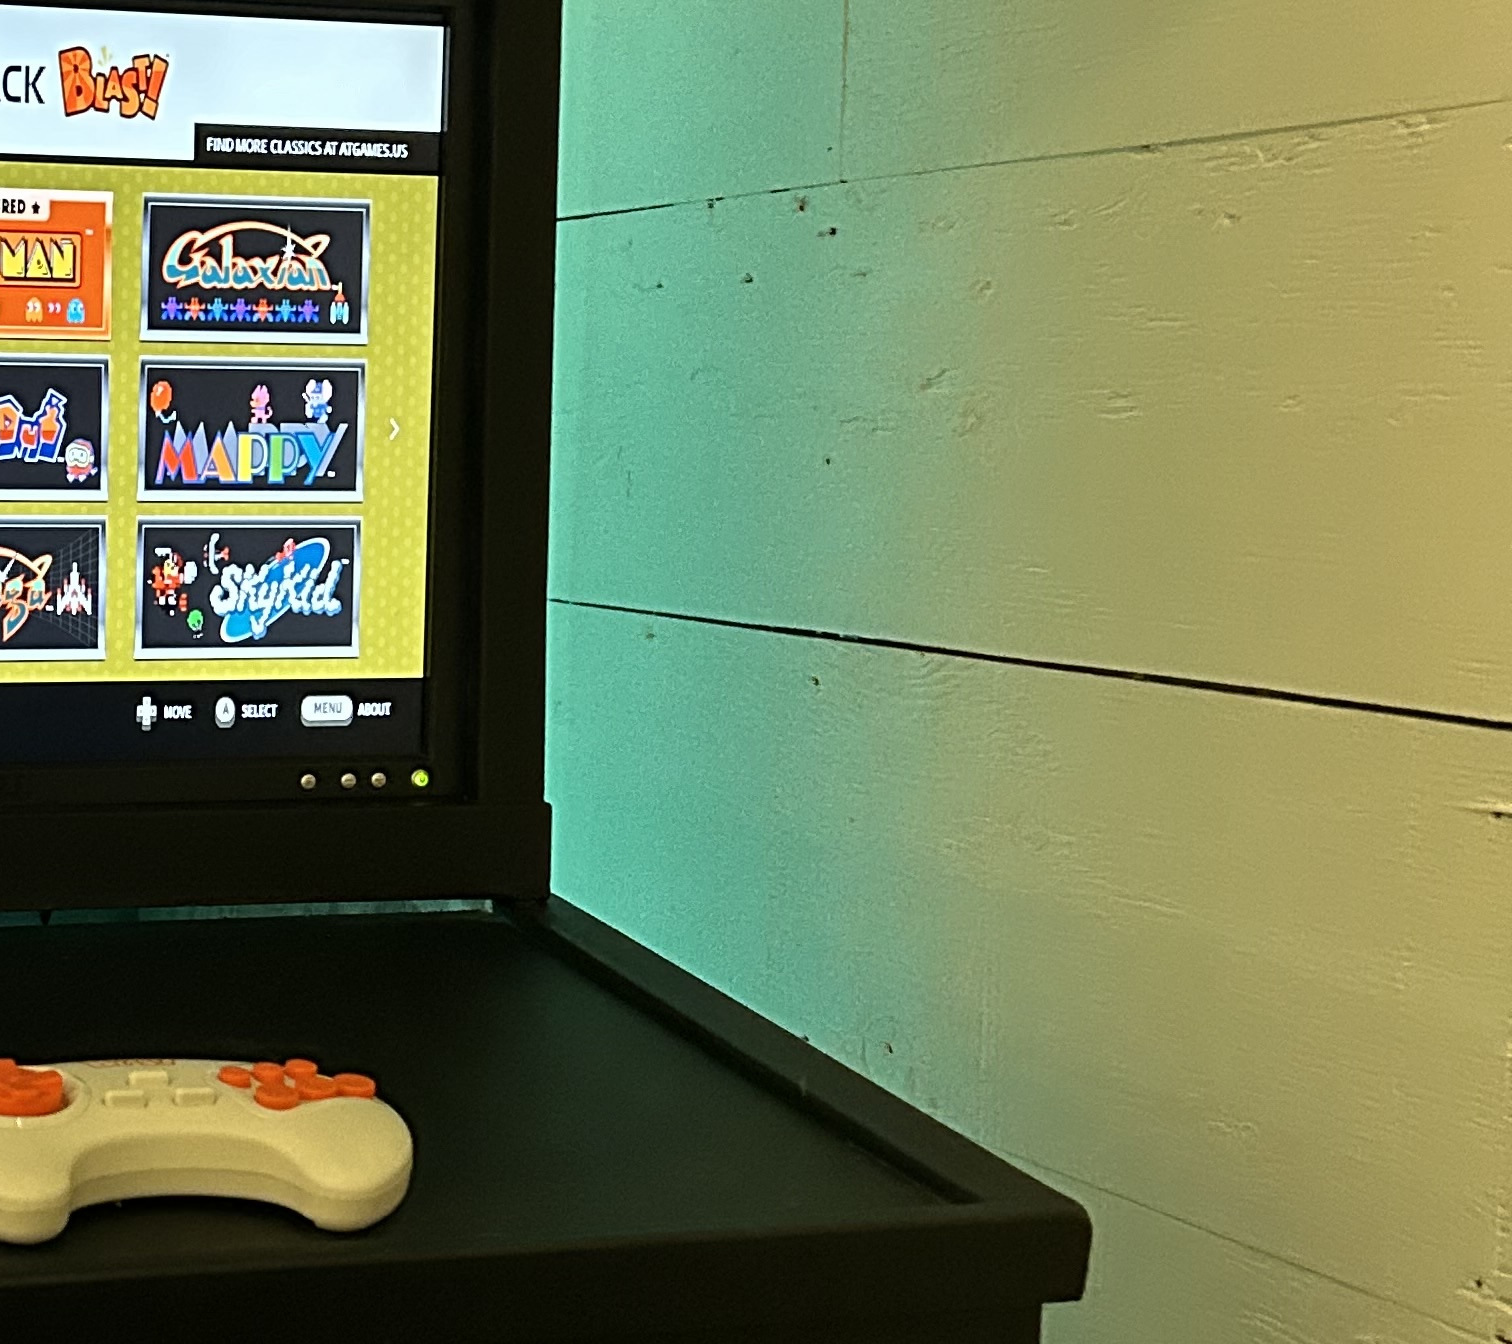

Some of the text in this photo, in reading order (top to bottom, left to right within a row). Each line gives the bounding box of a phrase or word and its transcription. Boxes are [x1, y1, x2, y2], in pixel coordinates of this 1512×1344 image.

[206, 137, 409, 158] FIND MORE CLASSICS AT ATGAMES.US
[154, 423, 345, 485] MAPPY
[163, 704, 193, 720] MOVE
[222, 703, 230, 715] A
[241, 703, 278, 719] SELECT
[313, 701, 343, 715] MENU
[357, 701, 392, 717] ABOUT
